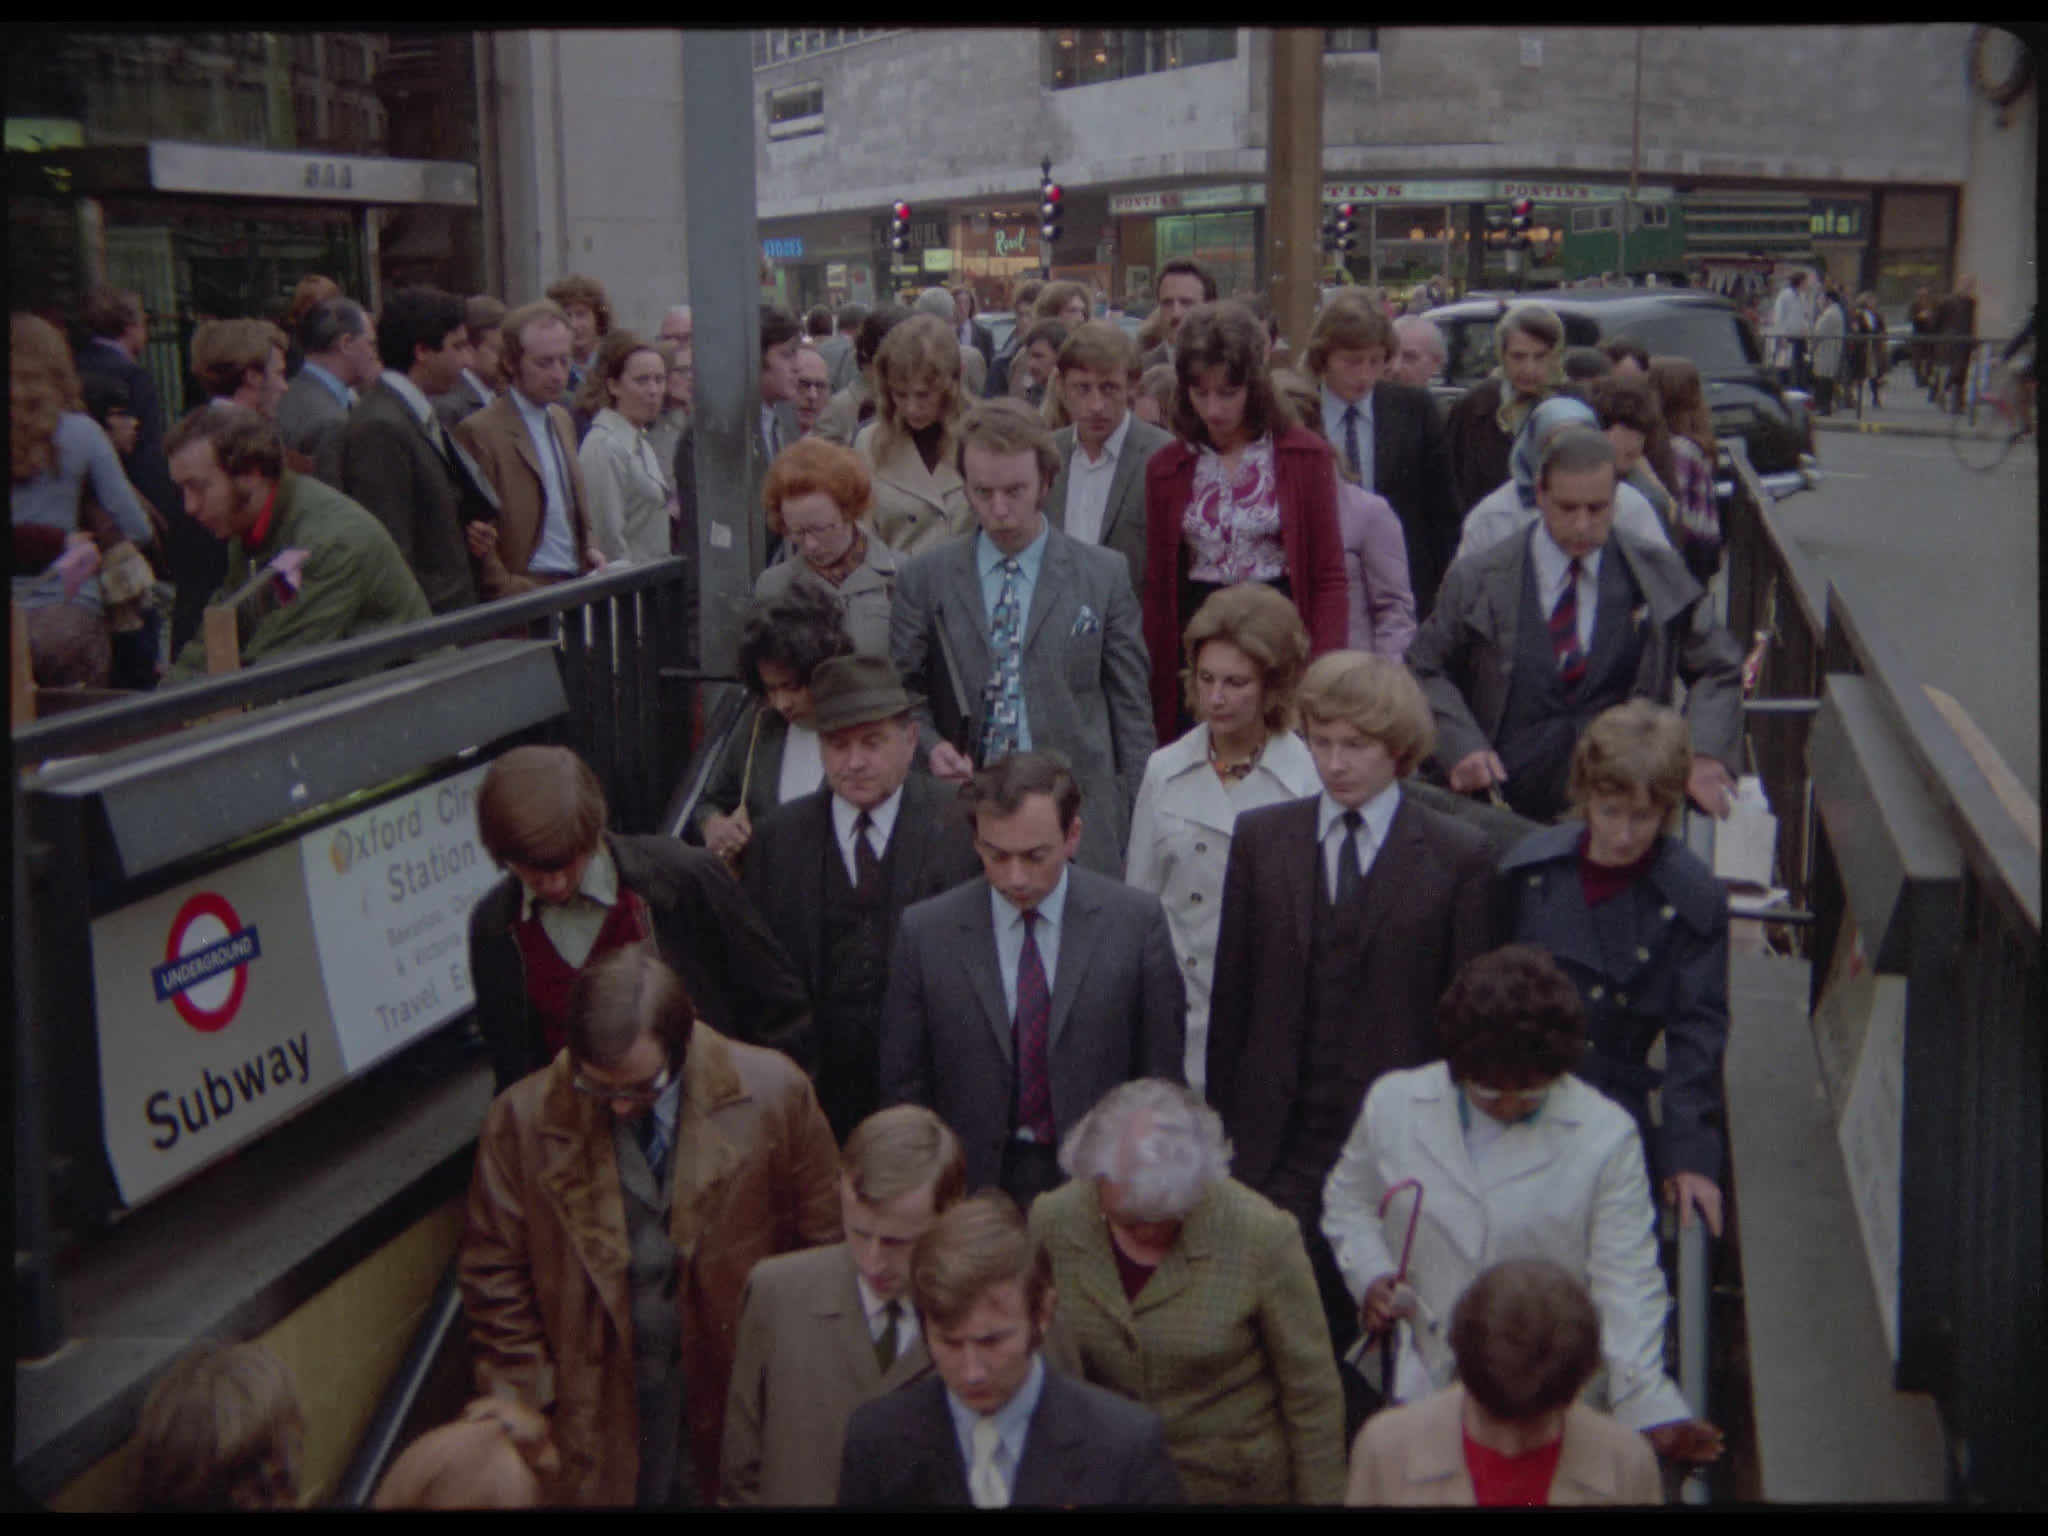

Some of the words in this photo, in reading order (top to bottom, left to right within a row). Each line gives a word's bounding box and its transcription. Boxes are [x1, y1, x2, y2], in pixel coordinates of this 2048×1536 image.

[330, 799, 423, 875] Oxford
[386, 839, 477, 904] Station
[160, 933, 253, 991] UNDERGROUND
[375, 975, 441, 1034] Travel
[145, 1030, 311, 1153] Subway
